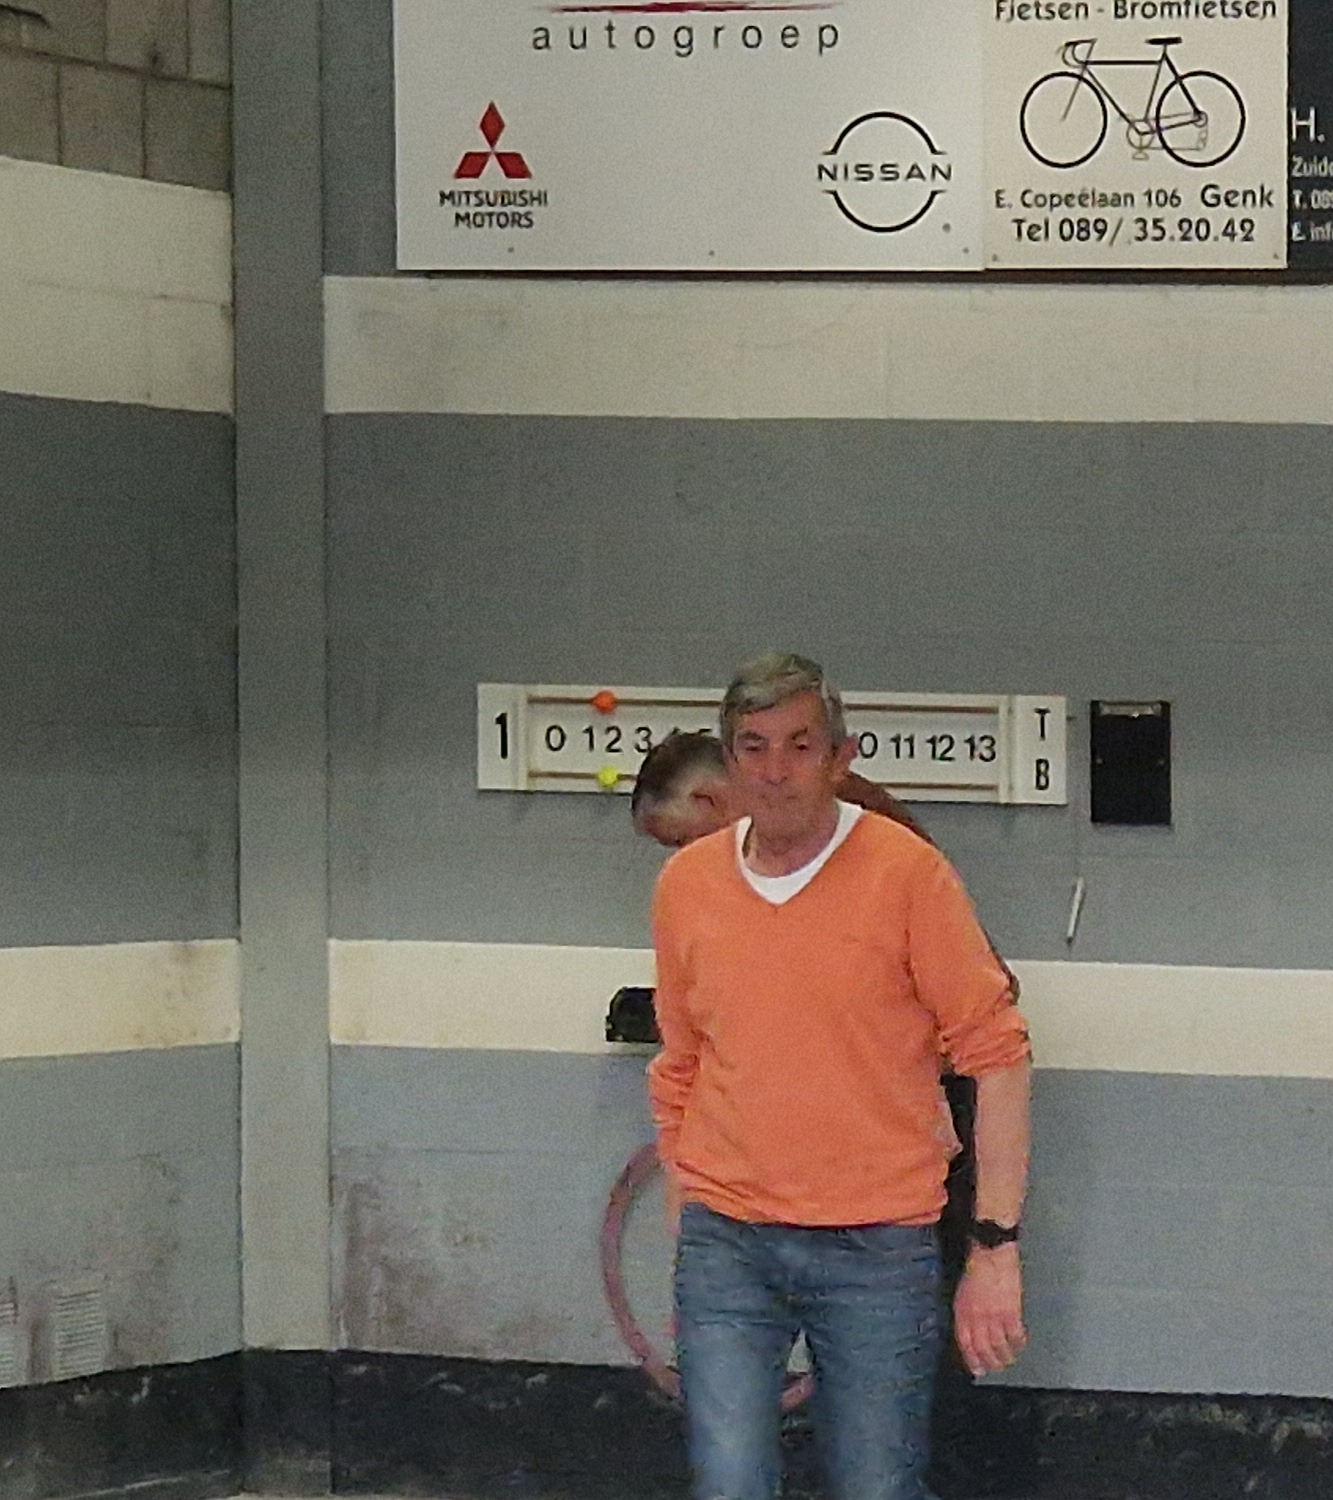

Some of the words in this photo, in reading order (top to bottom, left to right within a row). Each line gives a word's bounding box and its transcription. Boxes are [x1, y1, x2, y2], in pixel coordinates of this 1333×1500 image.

[1114, 0, 1277, 20] Bromfietsen
[532, 20, 840, 57] autogroep
[1290, 105, 1326, 142] H.
[817, 162, 953, 182] NISSAN
[439, 190, 549, 207] MITSUBISHI
[995, 189, 1014, 208] E.
[1143, 188, 1182, 208] 106
[1200, 183, 1274, 208] Genk
[454, 211, 533, 229] MOTORS
[1012, 218, 1049, 242] Tel
[1059, 217, 1124, 247] 089/
[1132, 217, 1256, 243] 35.20.42
[495, 712, 509, 759] 1
[545, 725, 566, 752] 0
[582, 726, 595, 751] 1
[605, 727, 623, 753] 2
[634, 727, 652, 753] 3
[1034, 708, 1051, 741] T
[890, 733, 915, 759] 11
[926, 735, 955, 761] 12
[964, 735, 996, 762] 13
[1035, 758, 1050, 790] B
